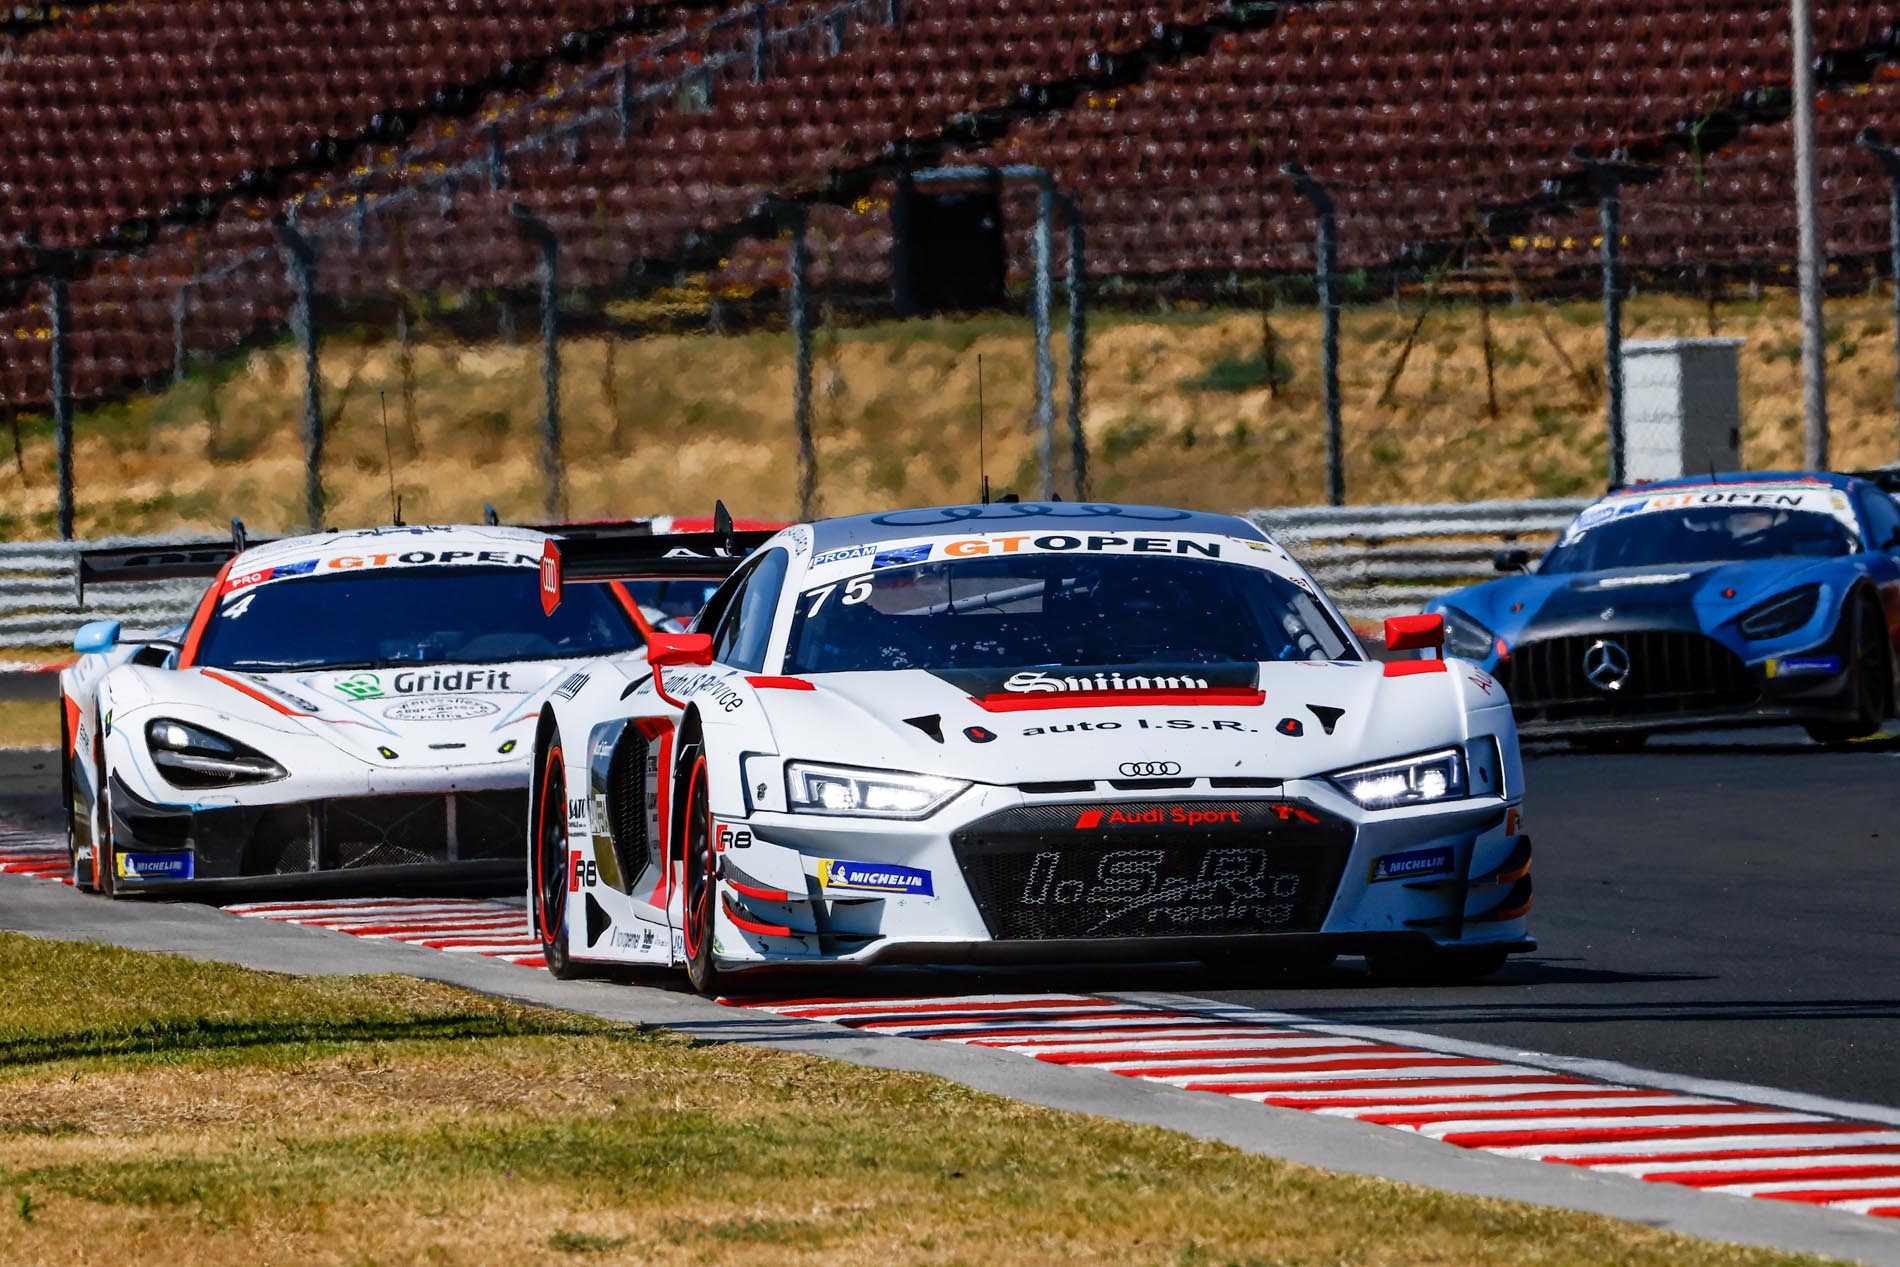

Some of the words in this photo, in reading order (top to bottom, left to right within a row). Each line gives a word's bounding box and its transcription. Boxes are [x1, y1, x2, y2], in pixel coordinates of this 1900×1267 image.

[813, 546, 877, 566] PROAM
[232, 573, 262, 588] PRO
[807, 574, 876, 618] 75
[222, 594, 256, 619] 4
[393, 670, 511, 693] GridFit
[1022, 722, 1122, 737] auto
[1138, 719, 1259, 733] I.S.R.
[1108, 807, 1165, 824] Audi
[1170, 807, 1241, 826] Sport
[721, 831, 752, 849] R8
[137, 861, 183, 872] MICHELIN
[574, 860, 597, 887] R8
[1390, 856, 1445, 873] MICHELIN
[849, 870, 923, 887] MICHELIN
